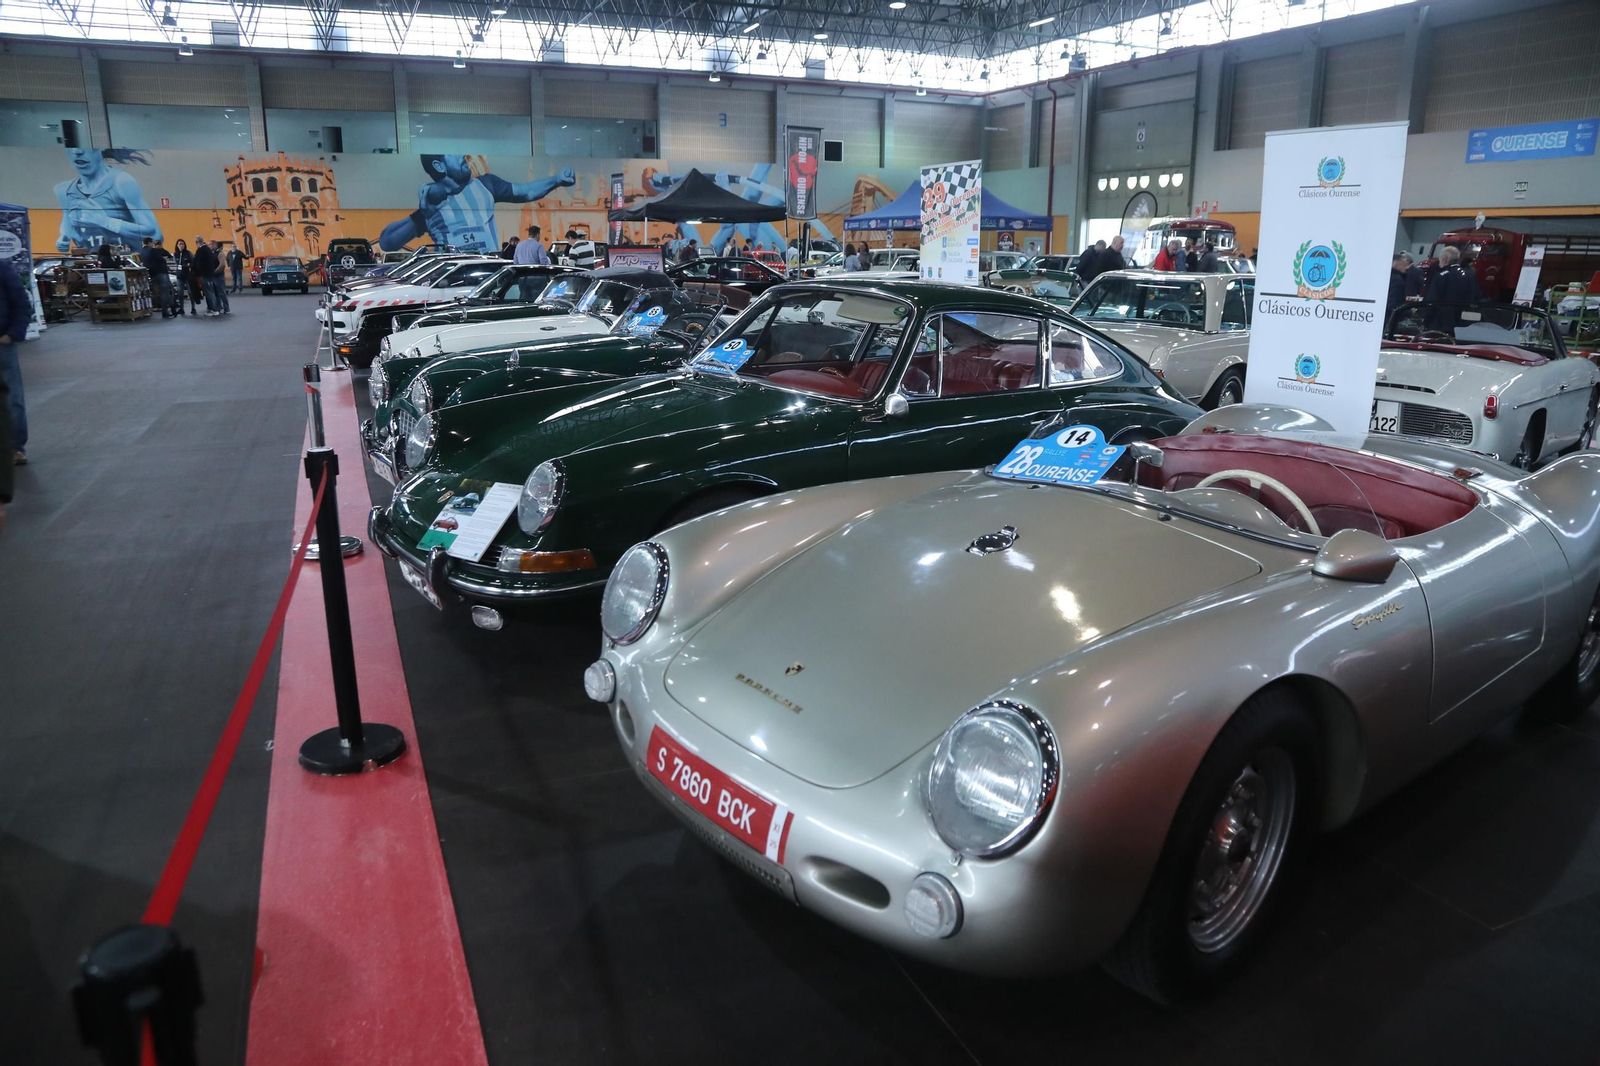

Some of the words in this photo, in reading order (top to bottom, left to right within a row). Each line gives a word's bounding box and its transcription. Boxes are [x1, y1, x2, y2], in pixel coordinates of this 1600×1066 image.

[798, 136, 807, 163] NIPON
[1492, 131, 1569, 153] OURENSE
[796, 177, 806, 215] OURENSE
[923, 181, 946, 209] 29
[950, 186, 979, 207] Ourense
[1298, 189, 1327, 198] Clásicos
[1328, 189, 1361, 198] Ourense
[462, 233, 476, 244] 54
[611, 254, 640, 267] AUTO
[1258, 299, 1311, 318] Clásicos
[1314, 303, 1374, 323] Ourense
[723, 341, 742, 350] 50
[1276, 381, 1304, 392] Clásicos
[1305, 386, 1335, 397] Ourense
[1063, 429, 1092, 446] 14
[998, 445, 1045, 475] 28
[1025, 463, 1099, 483] OURENSE
[656, 747, 667, 772] S
[670, 757, 712, 805] 7860
[717, 789, 757, 835] BCK
